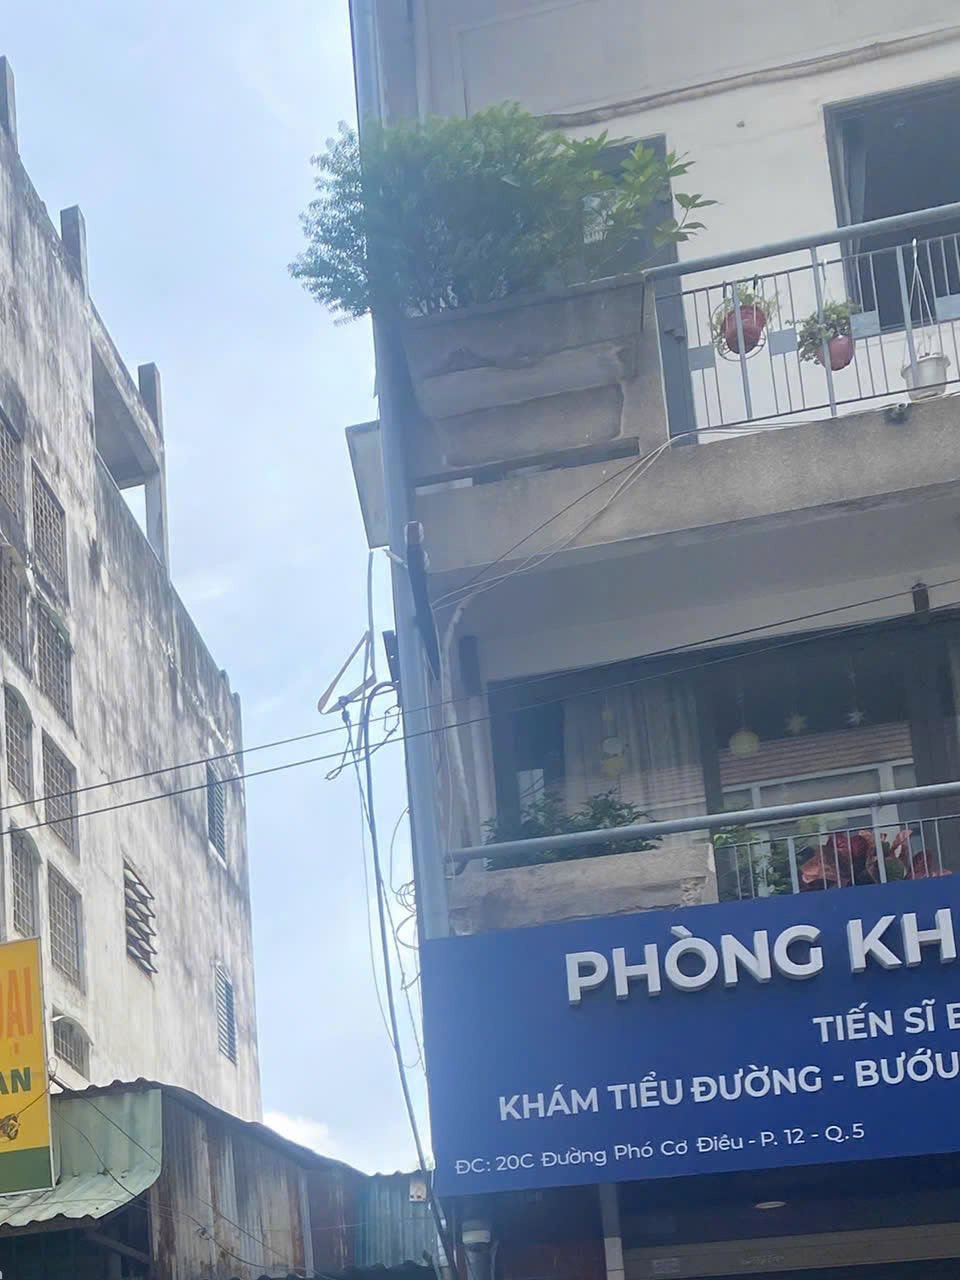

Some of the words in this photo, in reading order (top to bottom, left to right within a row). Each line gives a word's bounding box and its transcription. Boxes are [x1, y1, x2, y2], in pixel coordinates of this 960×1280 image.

[565, 924, 825, 1006] PHÒNG
[812, 1001, 894, 1043] TIẾN
[903, 998, 936, 1035] SĨ
[498, 1083, 599, 1121] KHÁM
[607, 1070, 683, 1111] TIỂU
[690, 1064, 823, 1103] ĐƯỜNG
[855, 1048, 960, 1088] BƯỚU
[455, 1157, 491, 1175] ĐC:
[495, 1153, 535, 1172] 20C
[541, 1147, 607, 1167] Đường
[614, 1140, 653, 1161] Phó
[661, 1140, 688, 1156] Cơ
[696, 1132, 744, 1153] Điều
[783, 1128, 806, 1146] 12
